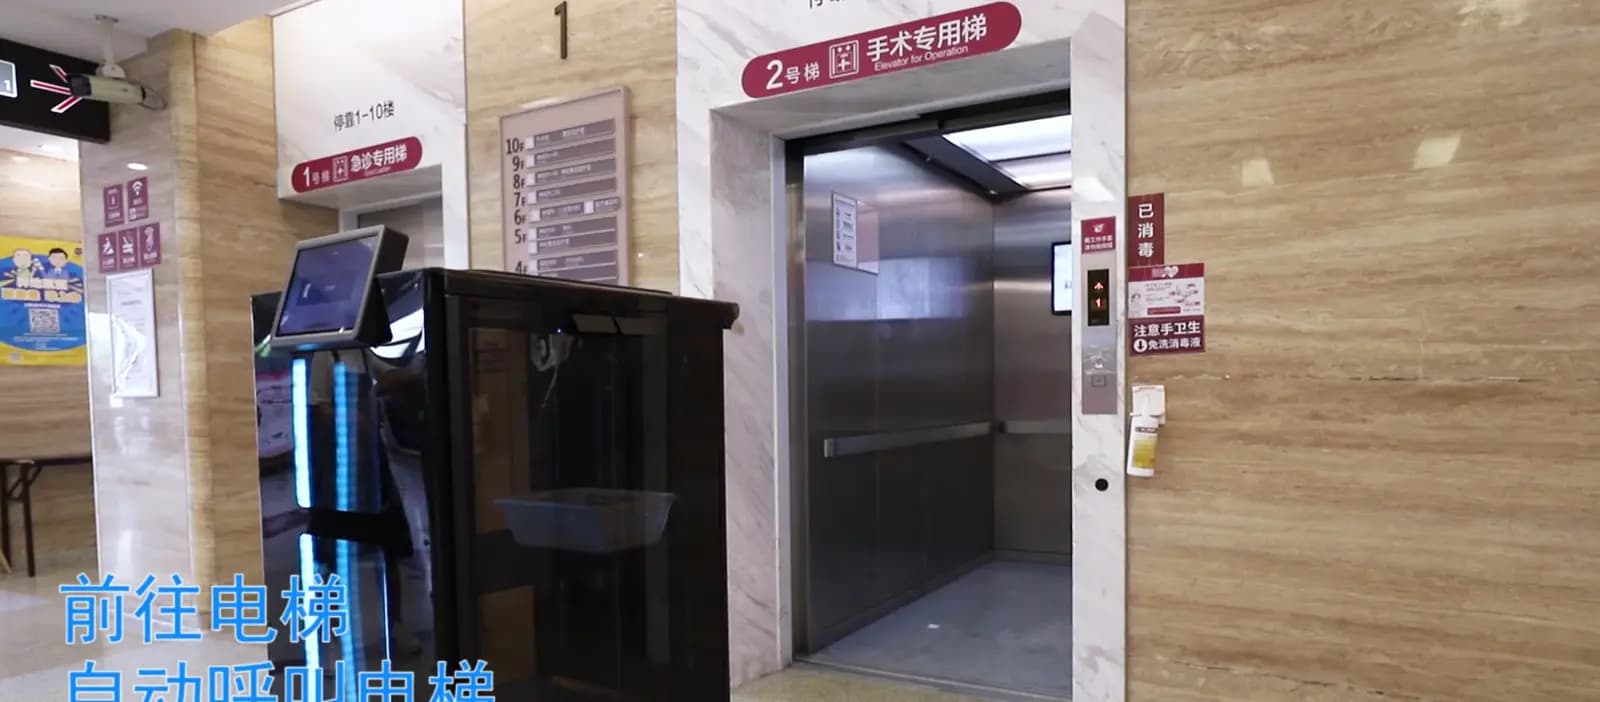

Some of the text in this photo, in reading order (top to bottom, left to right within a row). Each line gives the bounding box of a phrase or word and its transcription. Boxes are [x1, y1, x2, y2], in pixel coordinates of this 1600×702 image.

[554, 1, 568, 60] 1
[766, 13, 988, 90] 2号梯 手术专用梯
[874, 45, 969, 72] Elevator for Operation
[333, 100, 395, 132] 停靠1-10楼
[506, 138, 525, 155] 10F
[350, 143, 407, 173] 急诊专用梯
[512, 175, 525, 190] 8F
[513, 192, 526, 208] 7F
[514, 210, 526, 226] 6F
[514, 230, 527, 245] 5F
[1137, 203, 1154, 258] 已消毒
[1096, 298, 1102, 308] 1
[1134, 320, 1201, 338] 注意手卫生
[1148, 337, 1201, 352] 免洗消毒液
